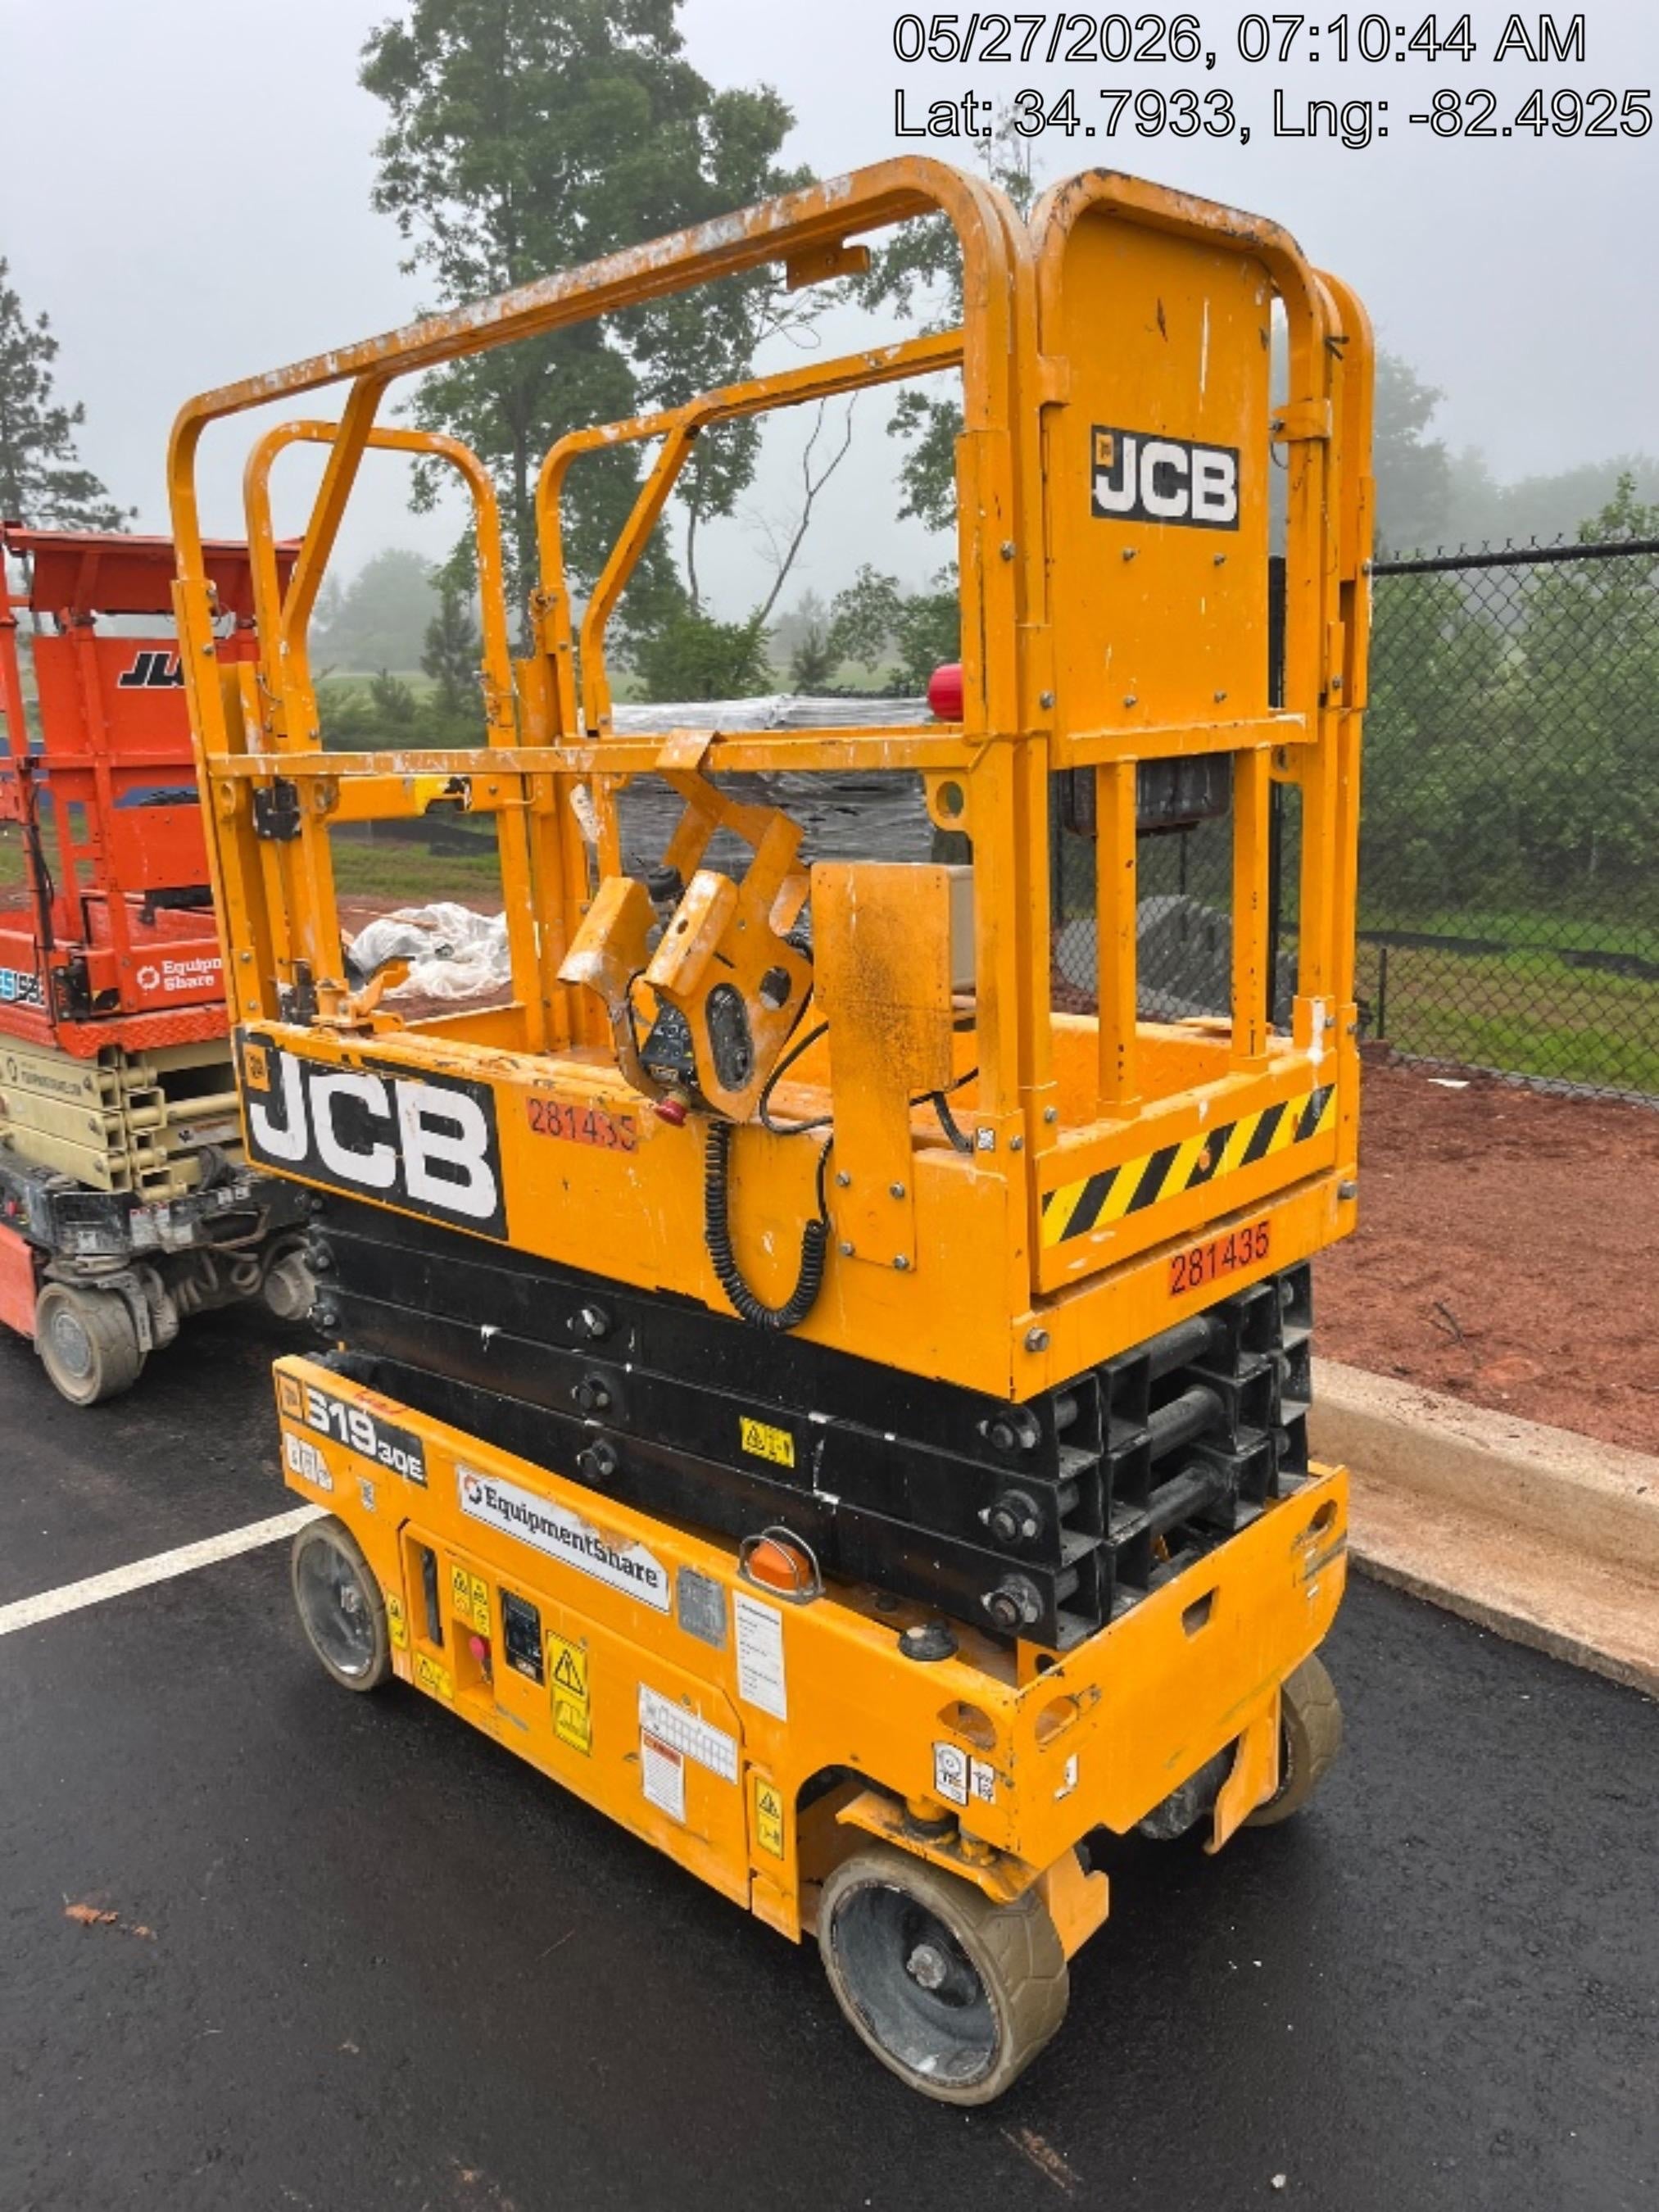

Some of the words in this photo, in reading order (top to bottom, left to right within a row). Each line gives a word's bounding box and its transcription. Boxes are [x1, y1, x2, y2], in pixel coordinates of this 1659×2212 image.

[1095, 437, 1238, 522] JCB
[250, 1050, 498, 1219] JCB
[530, 1098, 636, 1151] 281435
[1171, 1222, 1270, 1296] 281435
[483, 1484, 660, 1589] EquipmentShare
